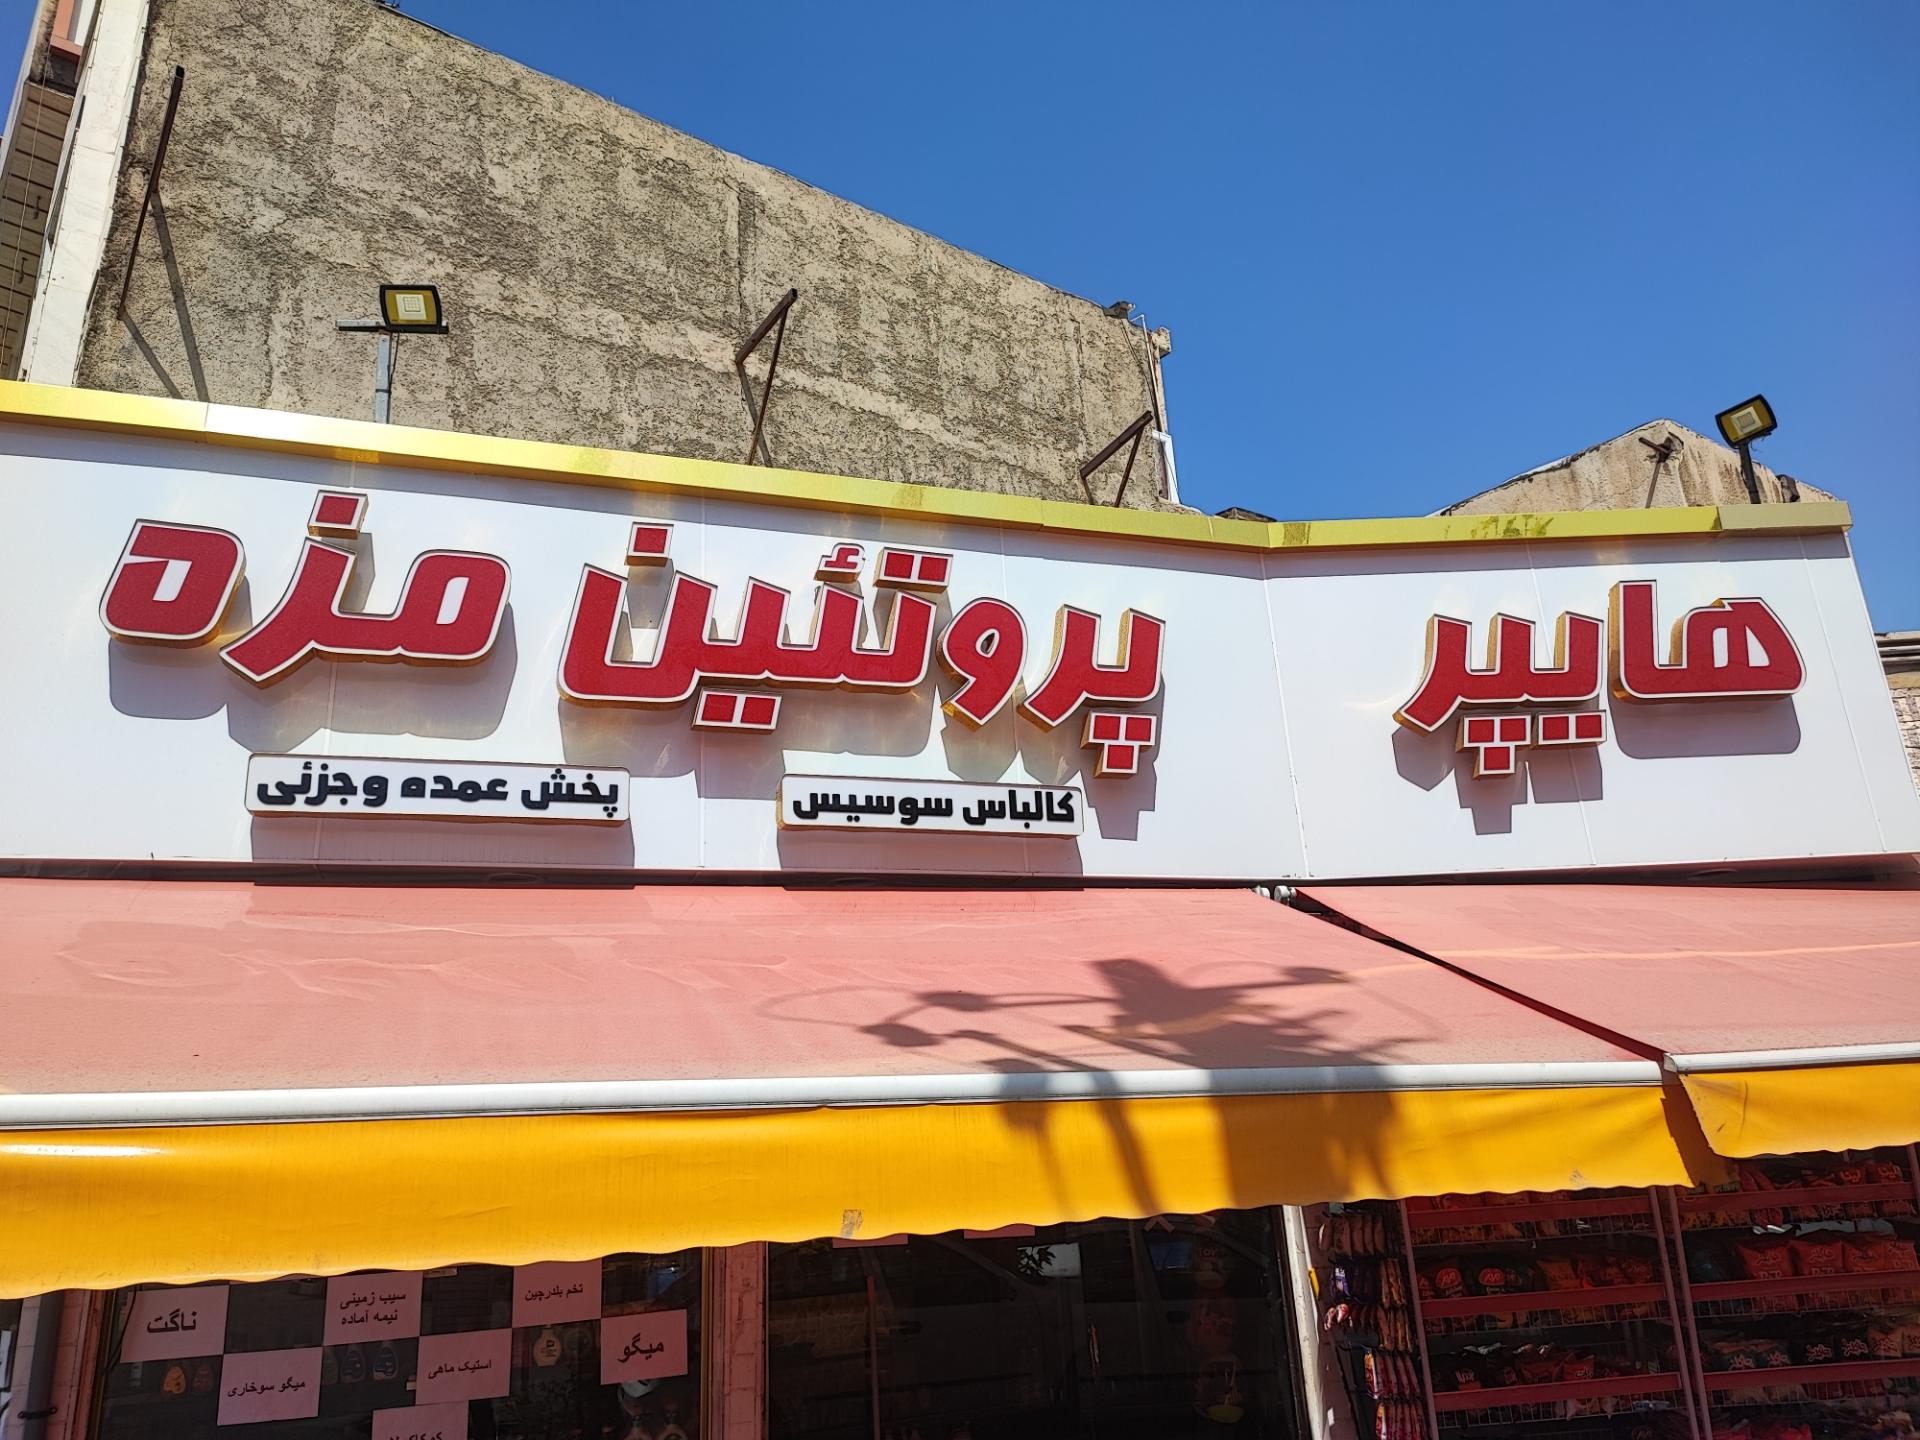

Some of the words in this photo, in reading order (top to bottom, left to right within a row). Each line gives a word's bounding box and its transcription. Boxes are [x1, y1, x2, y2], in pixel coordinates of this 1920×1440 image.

[99, 489, 512, 687] مزه
[556, 521, 1166, 776] پروتئین
[1395, 579, 1807, 776] هایپر
[400, 774, 509, 803] عمده
[520, 768, 620, 818] پخش
[792, 792, 954, 826] سوسیس
[962, 789, 1075, 828] کالباس
[340, 1291, 376, 1310] زمینی
[379, 1293, 407, 1305] سیب
[565, 1283, 584, 1299] تخم
[146, 1308, 197, 1333] ناگت
[341, 1309, 369, 1325] آماده
[373, 1309, 398, 1325] نیمه
[617, 1332, 665, 1364] میگو
[428, 1363, 455, 1380] ماهی
[458, 1359, 492, 1374] استیک
[227, 1382, 275, 1398] سوخاری
[278, 1376, 306, 1393] میگو
